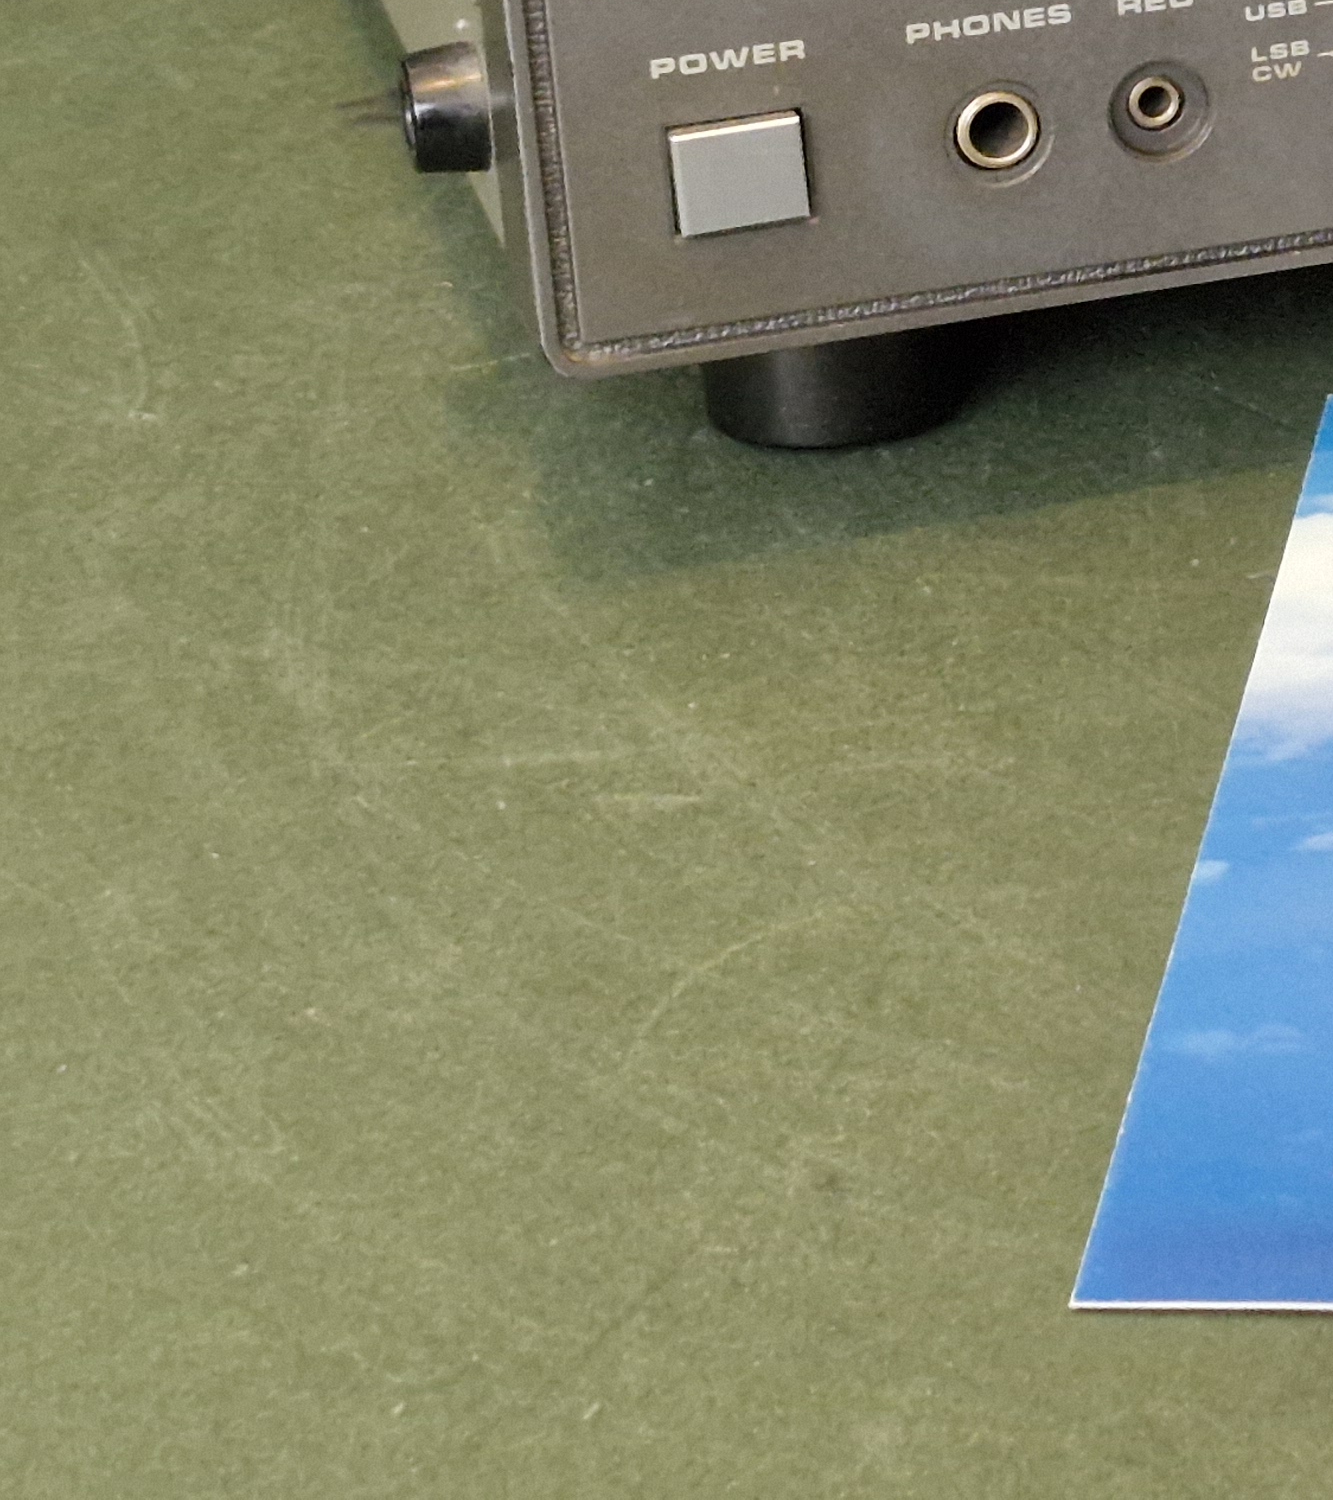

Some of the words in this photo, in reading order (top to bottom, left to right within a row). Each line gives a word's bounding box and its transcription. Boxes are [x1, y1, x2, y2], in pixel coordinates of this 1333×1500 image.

[906, 4, 1072, 45] PHONES
[650, 39, 806, 80] POWER
[1251, 40, 1310, 63] LSB
[1251, 62, 1303, 82] CW
